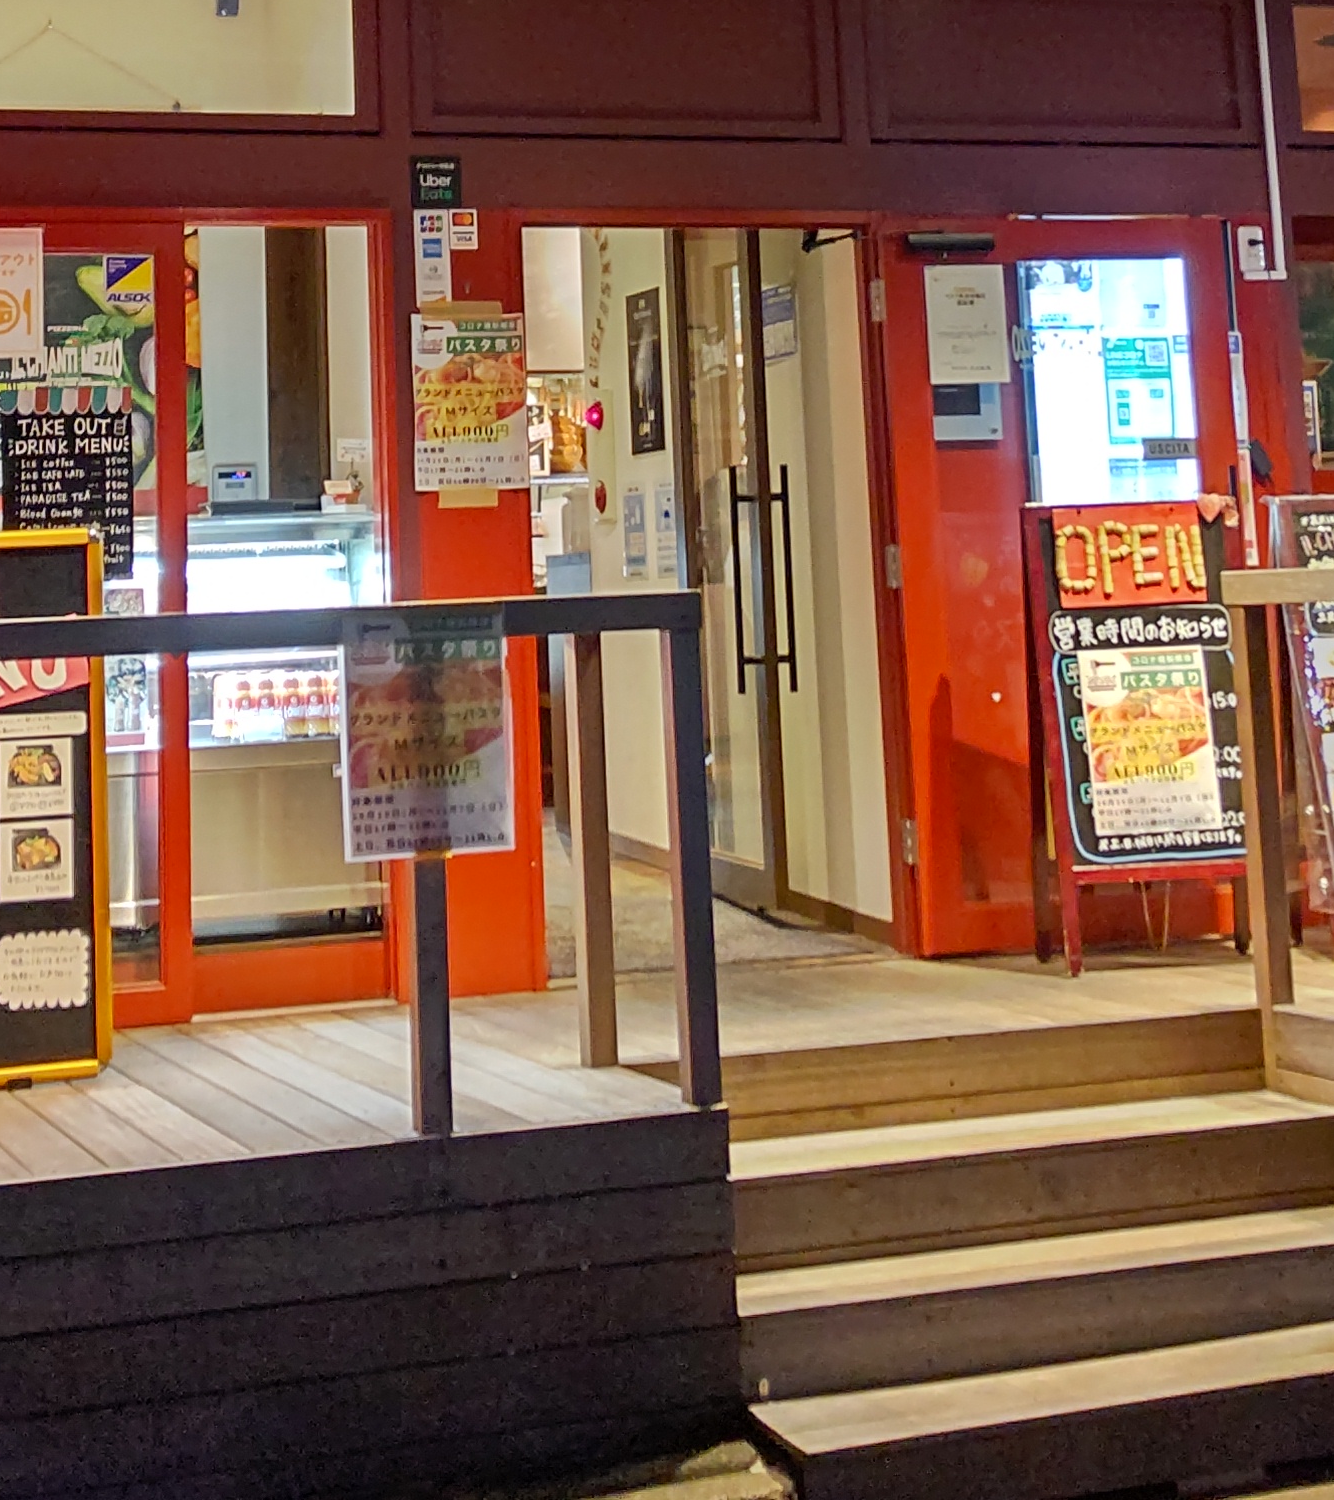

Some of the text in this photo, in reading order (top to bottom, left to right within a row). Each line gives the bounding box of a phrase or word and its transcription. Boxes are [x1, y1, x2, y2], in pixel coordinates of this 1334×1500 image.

[419, 173, 452, 187] Uber
[106, 293, 151, 303] ALSOK
[448, 338, 521, 353] パスタ祭り
[17, 417, 110, 437] TAKE OUT
[16, 437, 123, 455] DRINK MENU
[1148, 443, 1191, 455] USCITA
[71, 489, 92, 502] TEA
[1054, 519, 1208, 596] OPEN
[1053, 614, 1229, 651] 営業時間のお知らせ
[1122, 671, 1200, 689] パスタ祭り
